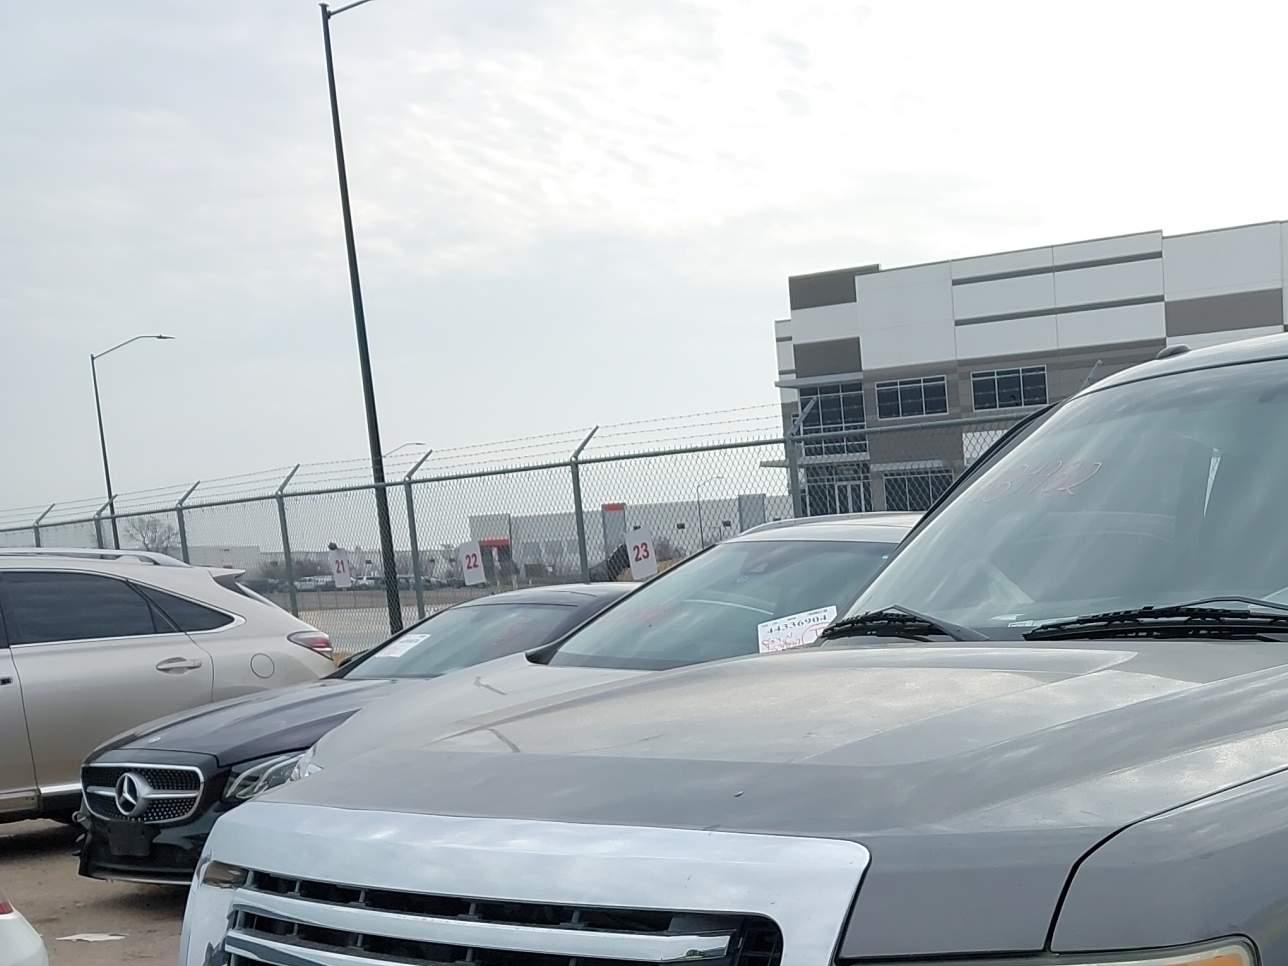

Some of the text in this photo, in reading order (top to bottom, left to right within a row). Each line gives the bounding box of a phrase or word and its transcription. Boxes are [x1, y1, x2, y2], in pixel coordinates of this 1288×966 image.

[465, 552, 479, 570] 22
[633, 542, 650, 562] 23
[335, 559, 346, 574] 21
